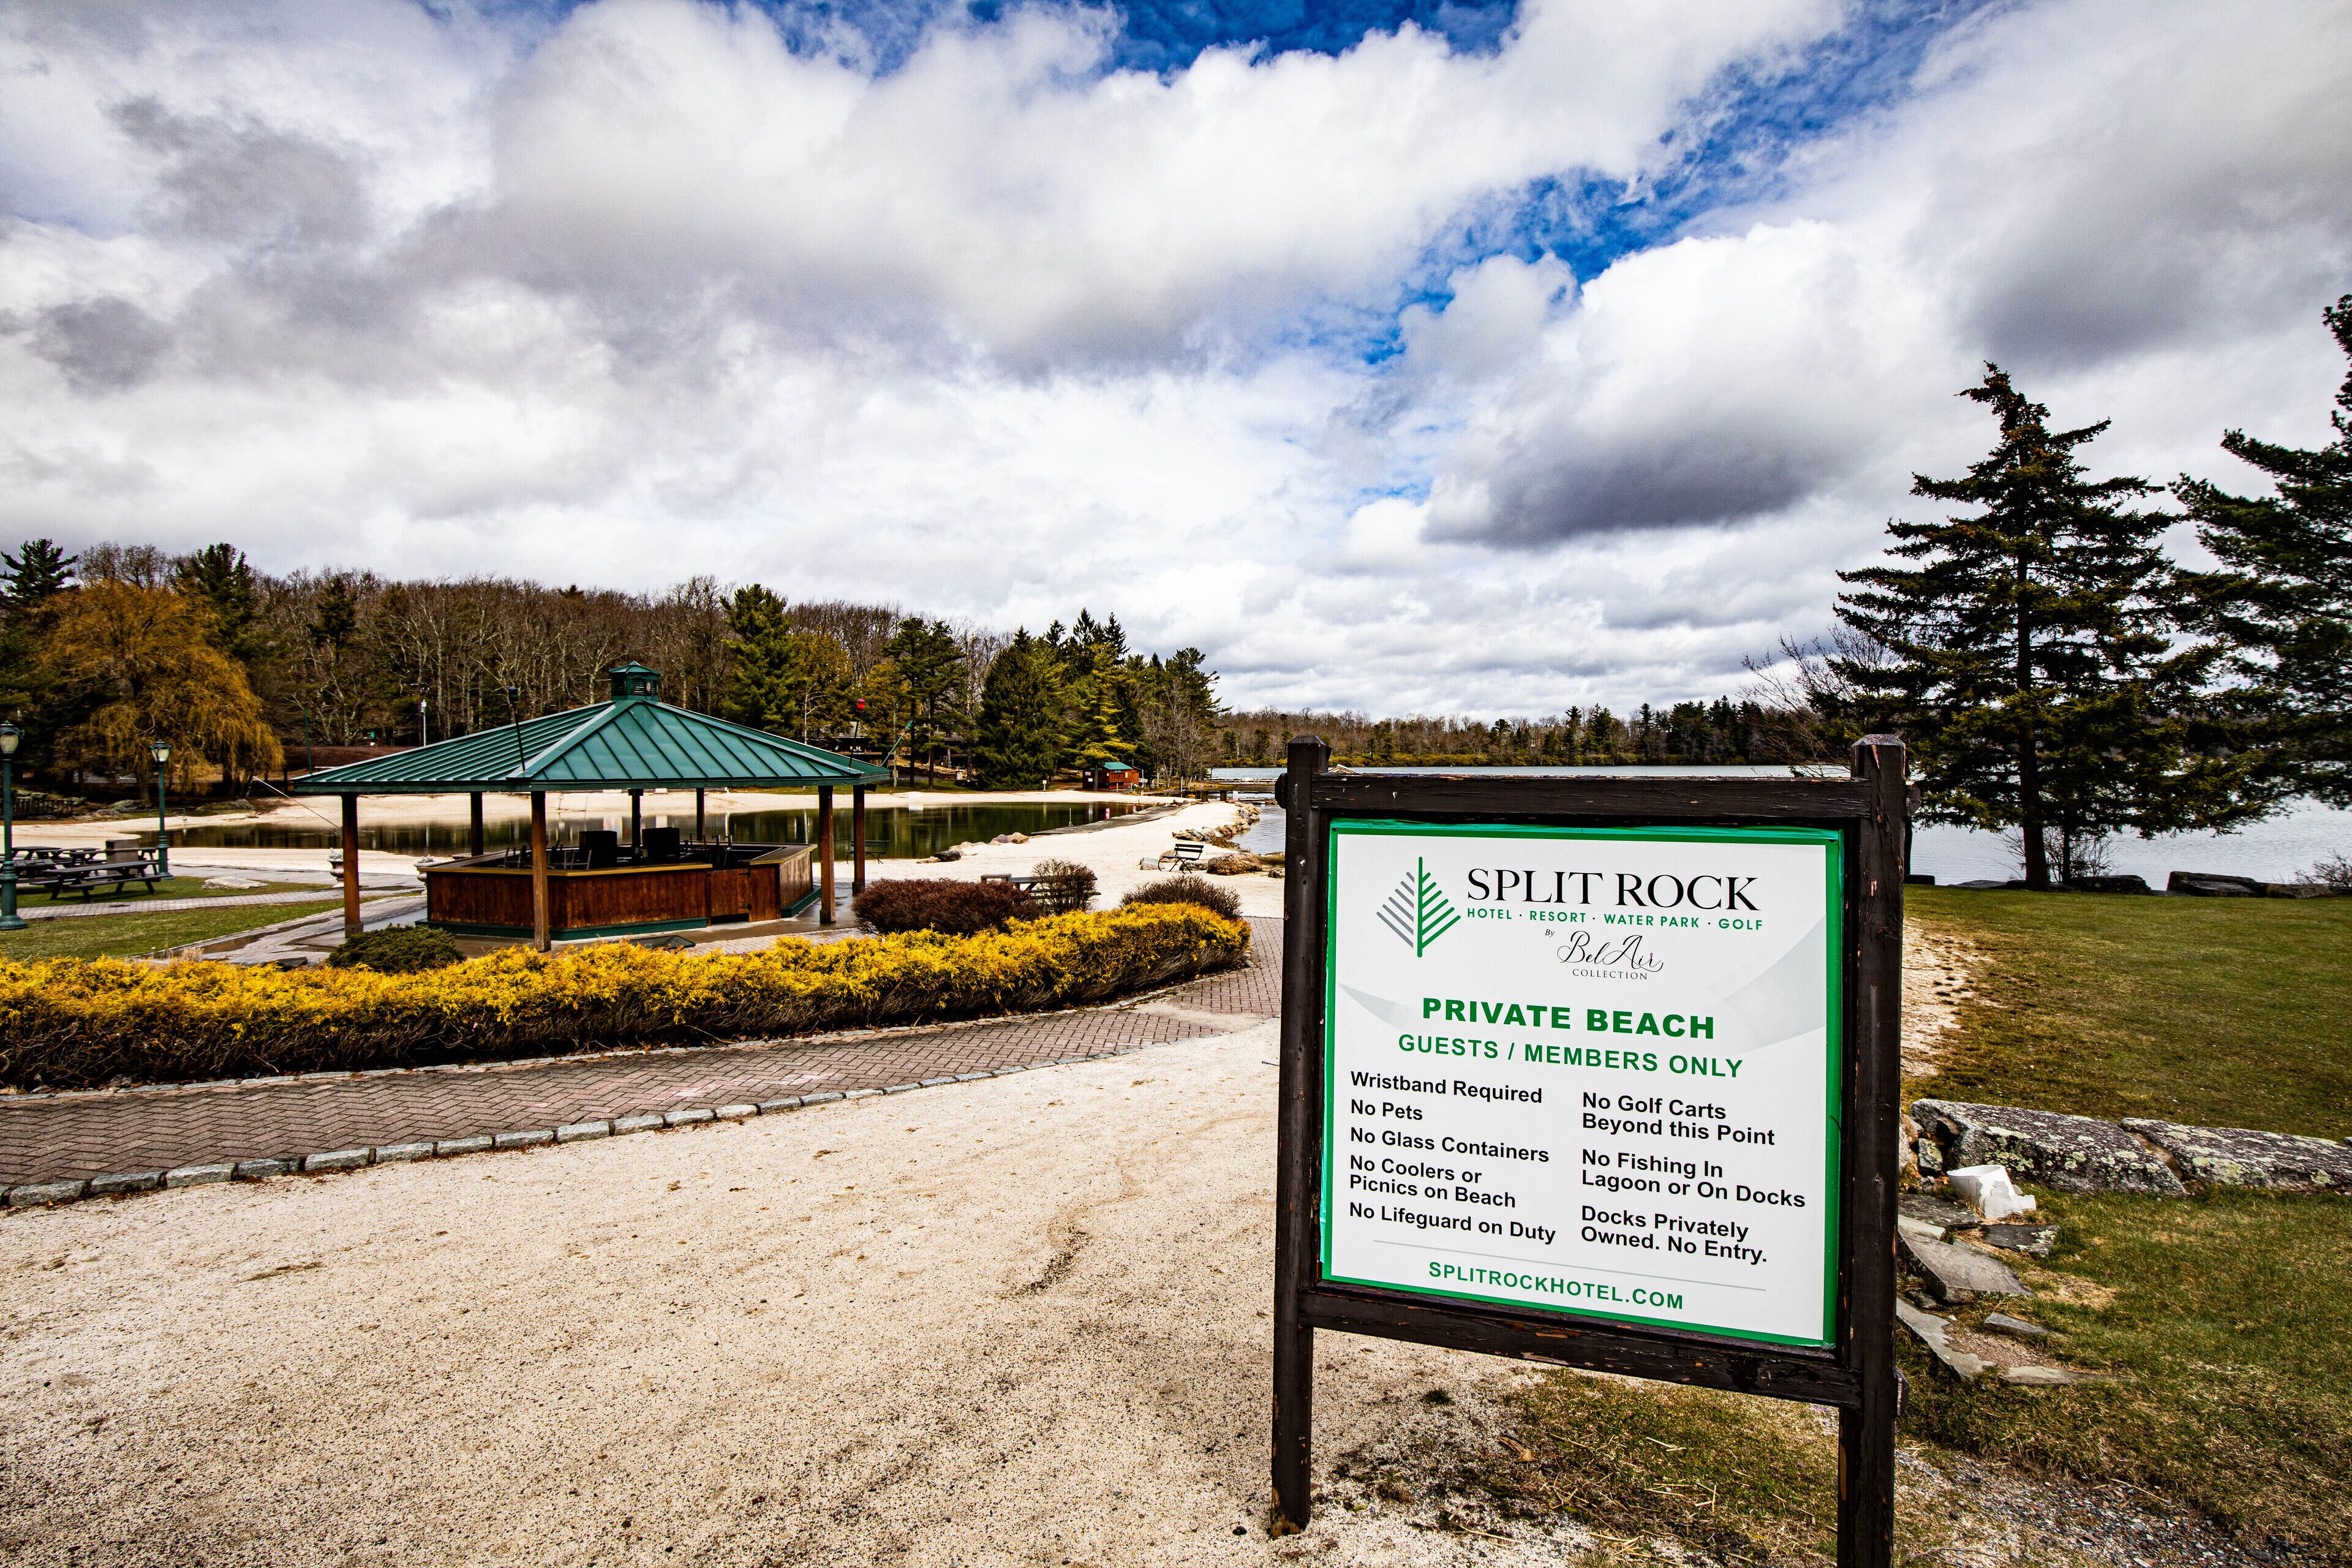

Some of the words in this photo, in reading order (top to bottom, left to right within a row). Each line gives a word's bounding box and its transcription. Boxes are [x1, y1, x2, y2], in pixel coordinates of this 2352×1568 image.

[1468, 868, 1604, 905] SPLIT
[1615, 873, 1760, 911] ROCK
[1467, 908, 1512, 919] HOTEL
[1529, 910, 1586, 923] RESORT
[1604, 913, 1654, 926] WATER
[1660, 916, 1699, 928] PARK
[1718, 918, 1762, 930] GOLF
[1545, 929, 1555, 938] By
[1572, 968, 1648, 980] COLLECTION
[1423, 997, 1570, 1030] PRIVATE
[1586, 1009, 1714, 1039] BEACH
[1398, 1034, 1498, 1059] GUESTS
[1507, 1042, 1515, 1060] /
[1525, 1044, 1658, 1072] MEMBERS
[1669, 1055, 1743, 1078] ONLY
[1350, 1071, 1446, 1095] Wristband
[1453, 1080, 1542, 1104] Required
[1351, 1099, 1376, 1116] No
[1382, 1102, 1423, 1121] Pets
[1583, 1091, 1611, 1110] No
[1618, 1095, 1663, 1114] Golf
[1668, 1099, 1727, 1120] Carts
[1351, 1126, 1376, 1144] No
[1382, 1130, 1435, 1150] Glass
[1441, 1136, 1549, 1163] Containers
[1583, 1112, 1662, 1136] Beyond
[1669, 1121, 1709, 1139] this
[1717, 1124, 1775, 1145] Point
[1350, 1155, 1375, 1172] No
[1381, 1158, 1455, 1182] Coolers
[1461, 1170, 1482, 1184] or
[1582, 1148, 1610, 1167] No
[1618, 1152, 1696, 1180] Fishing
[1704, 1160, 1723, 1178] In
[1350, 1174, 1419, 1196] Picnics
[1424, 1186, 1448, 1200] on
[1455, 1186, 1515, 1208] Beach
[1582, 1169, 1660, 1193] Lagoon
[1668, 1182, 1691, 1196] or
[1697, 1181, 1728, 1200] On
[1736, 1185, 1806, 1208] Docks
[1350, 1202, 1374, 1219] No
[1381, 1205, 1471, 1231] Lifeguard
[1478, 1221, 1502, 1235] on
[1510, 1221, 1556, 1245] Duty
[1581, 1205, 1646, 1227] Docks
[1654, 1213, 1749, 1243] Privately
[1581, 1226, 1660, 1250] Owned.
[1668, 1235, 1697, 1254] No
[1705, 1239, 1767, 1265] Entry.
[1428, 1262, 1683, 1310] SPLITROCKHOTEL.COM
